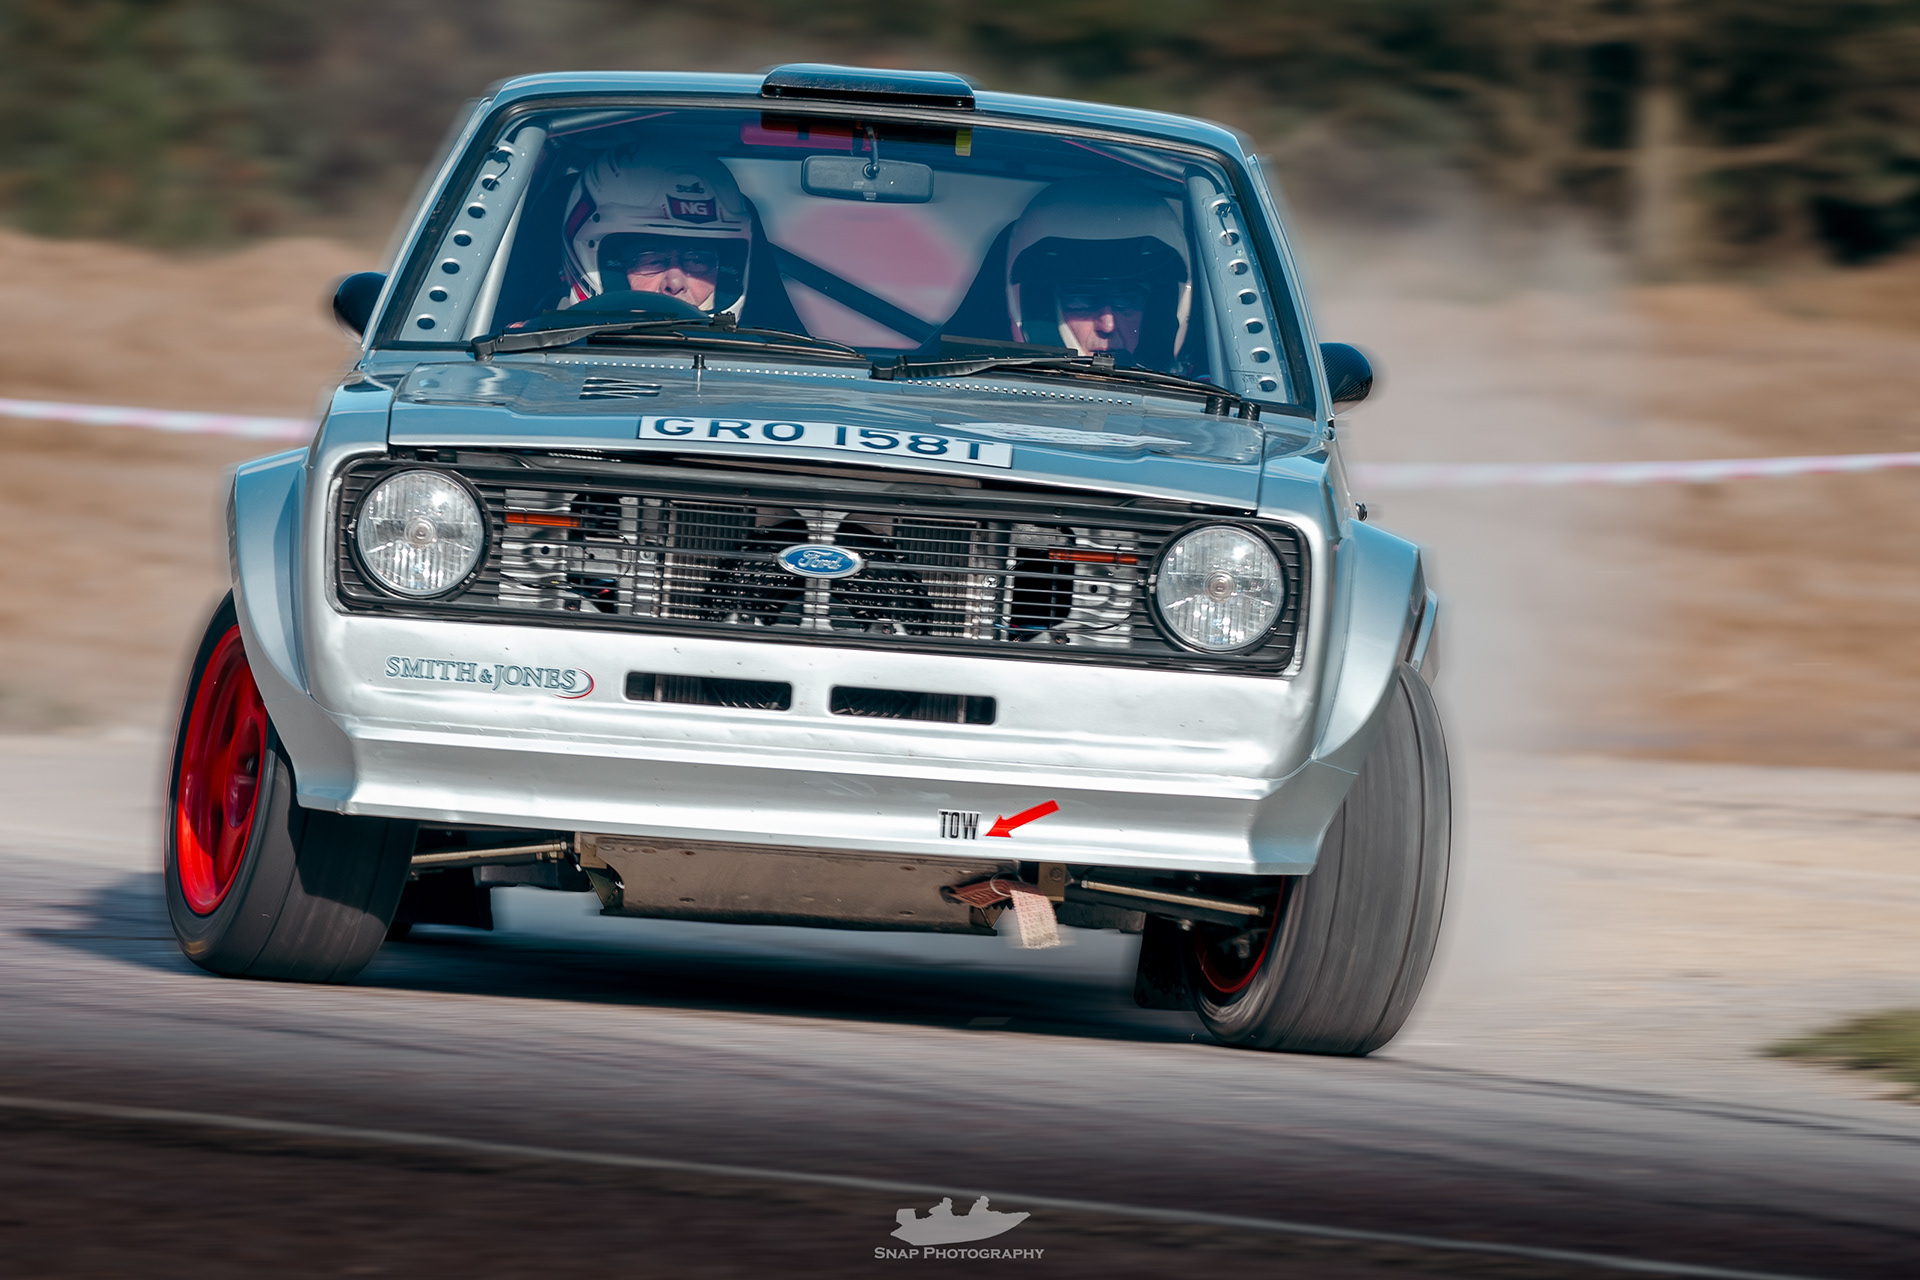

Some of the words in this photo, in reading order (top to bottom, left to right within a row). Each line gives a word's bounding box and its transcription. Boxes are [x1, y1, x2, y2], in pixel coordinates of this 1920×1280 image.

[679, 201, 708, 216] NG
[654, 417, 803, 442] GRO
[834, 425, 994, 460] 158T
[798, 550, 844, 570] Ford
[938, 810, 980, 840] TOW
